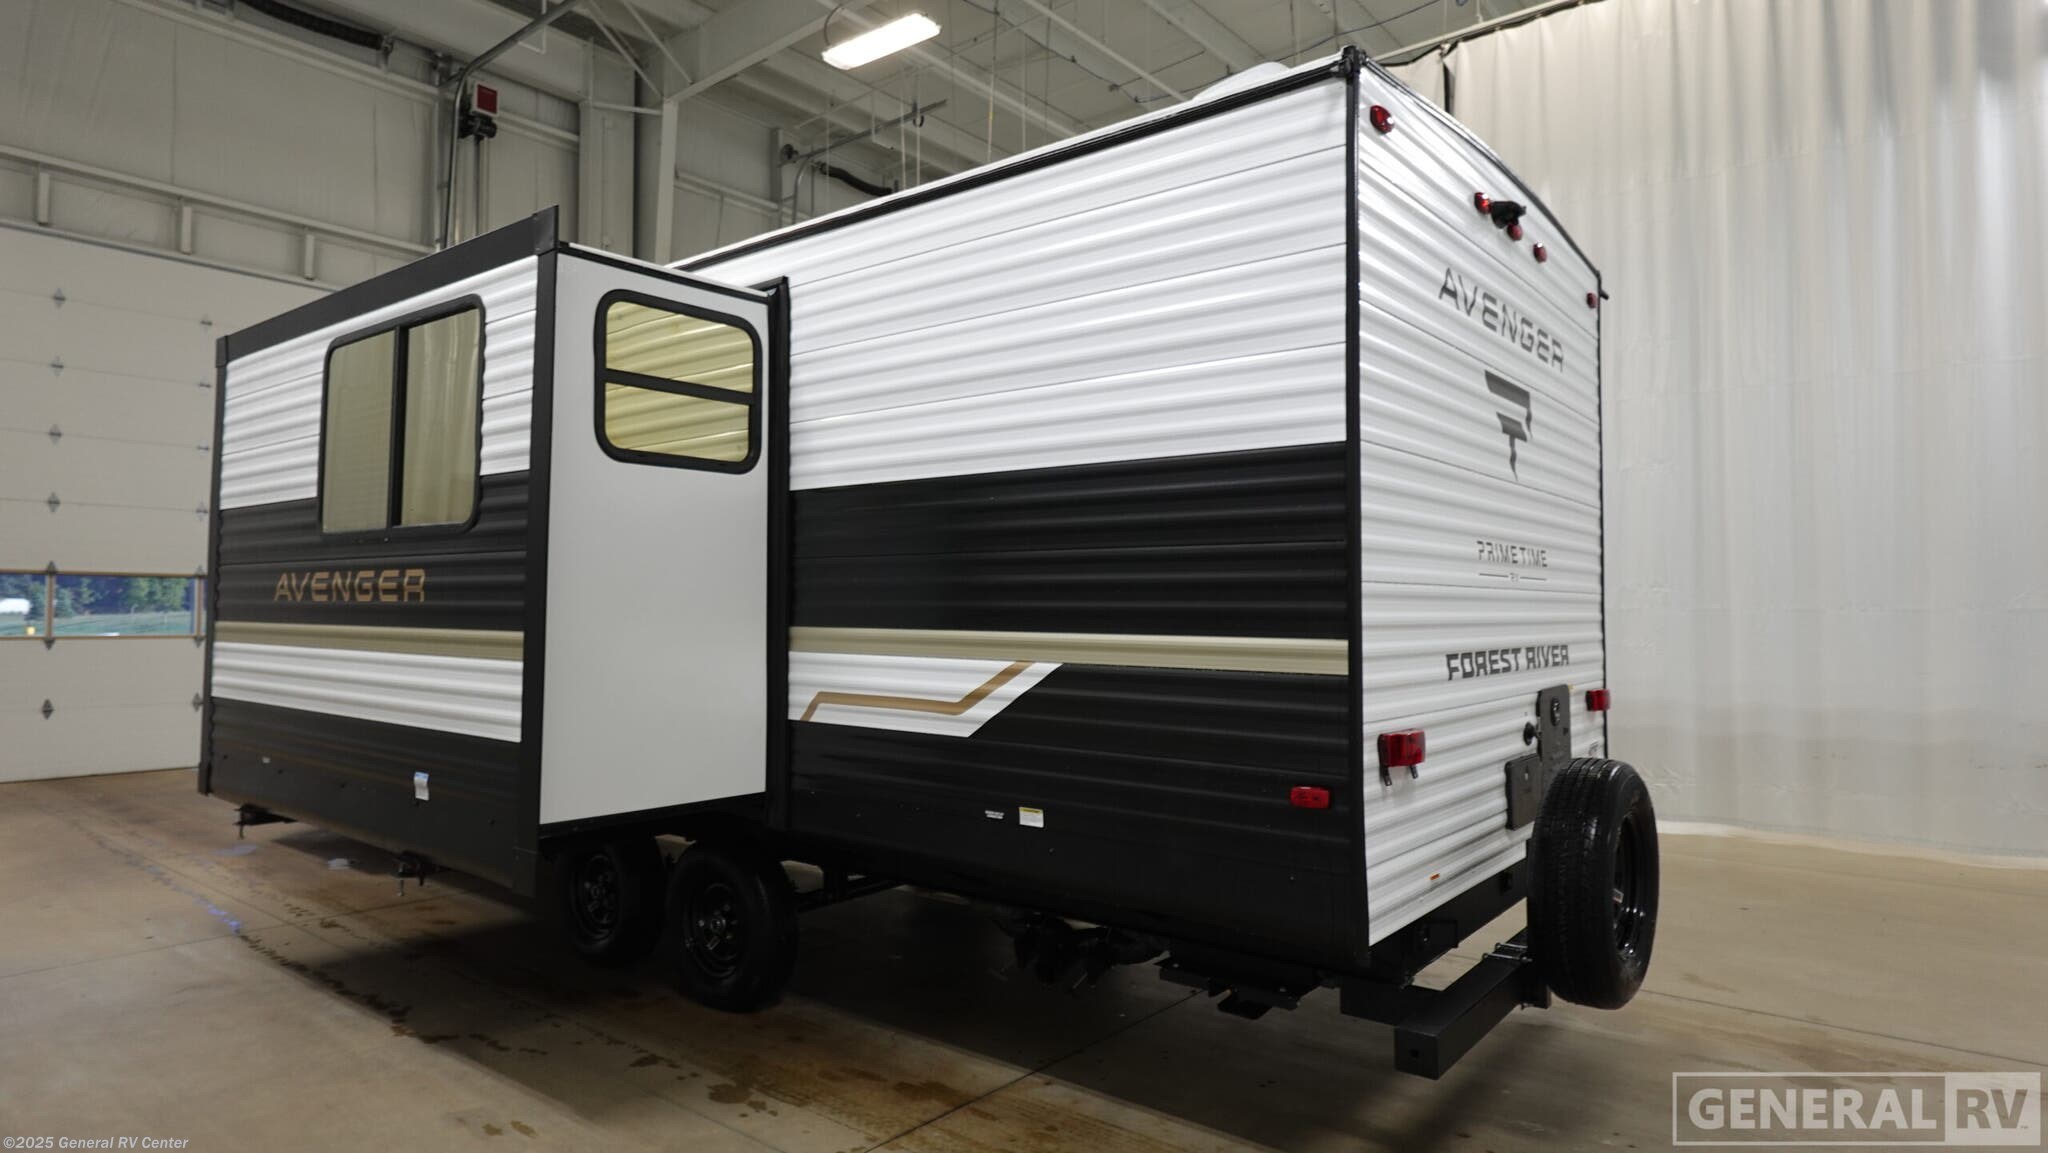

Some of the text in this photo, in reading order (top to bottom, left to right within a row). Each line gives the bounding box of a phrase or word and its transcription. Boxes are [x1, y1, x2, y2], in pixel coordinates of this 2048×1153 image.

[1438, 267, 1564, 372] AVENGER
[274, 568, 425, 602] AVENGER
[1446, 644, 1569, 681] FOREST RIVER
